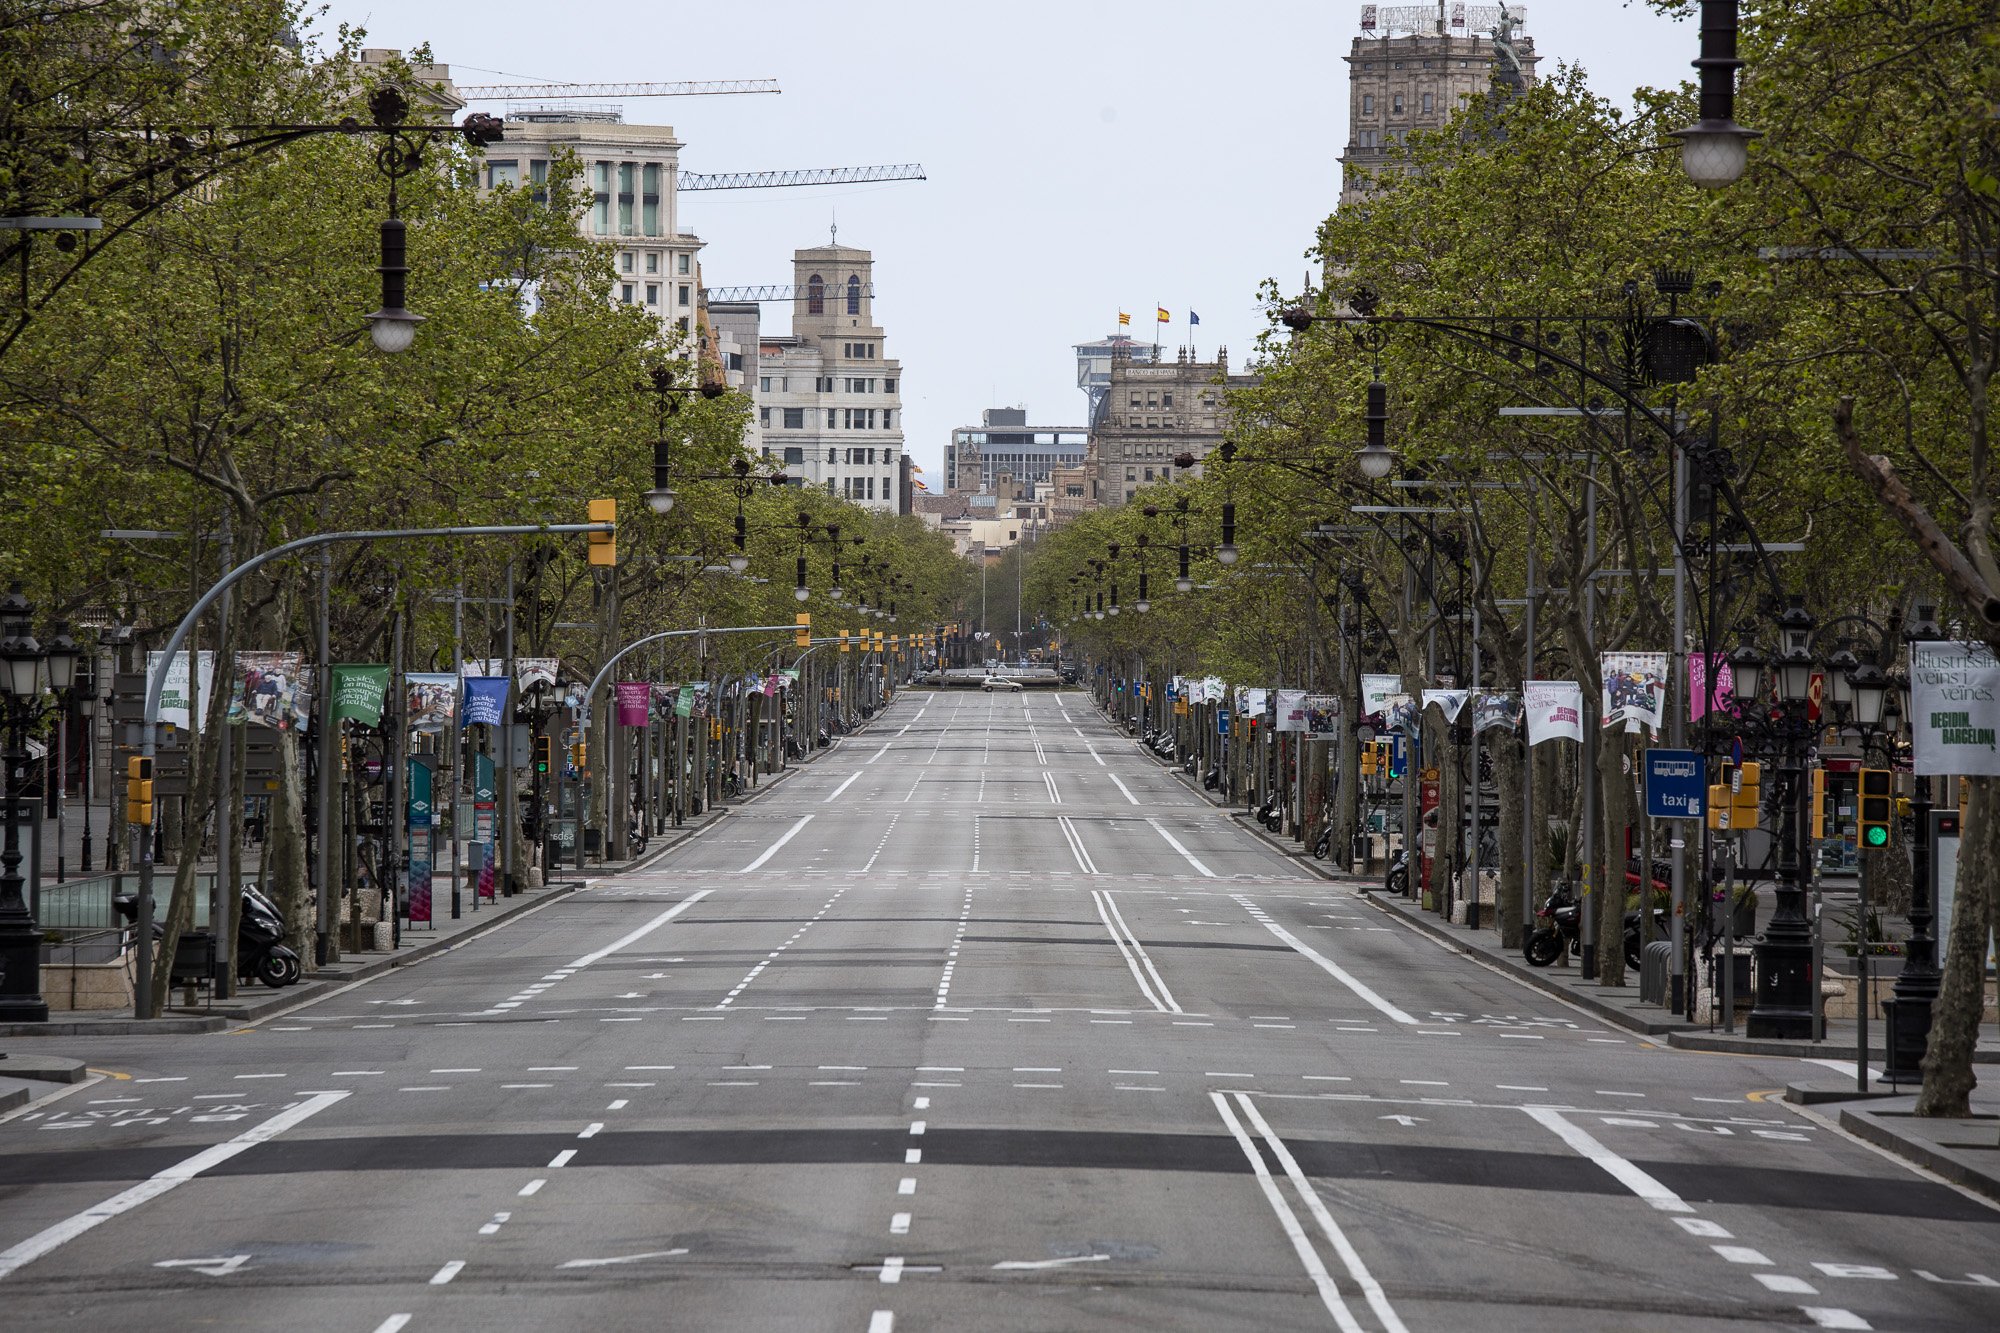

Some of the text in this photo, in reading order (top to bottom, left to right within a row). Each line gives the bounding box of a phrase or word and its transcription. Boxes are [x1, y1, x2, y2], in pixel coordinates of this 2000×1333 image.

[1961, 669, 1967, 685] i
[1813, 684, 1822, 700] M
[160, 699, 190, 710] BARCELO
[1930, 712, 1972, 728] DECIDIM.
[1942, 729, 1996, 745] BARCELONA
[1662, 793, 1687, 807] taxi
[1600, 1117, 1812, 1142] BUS
